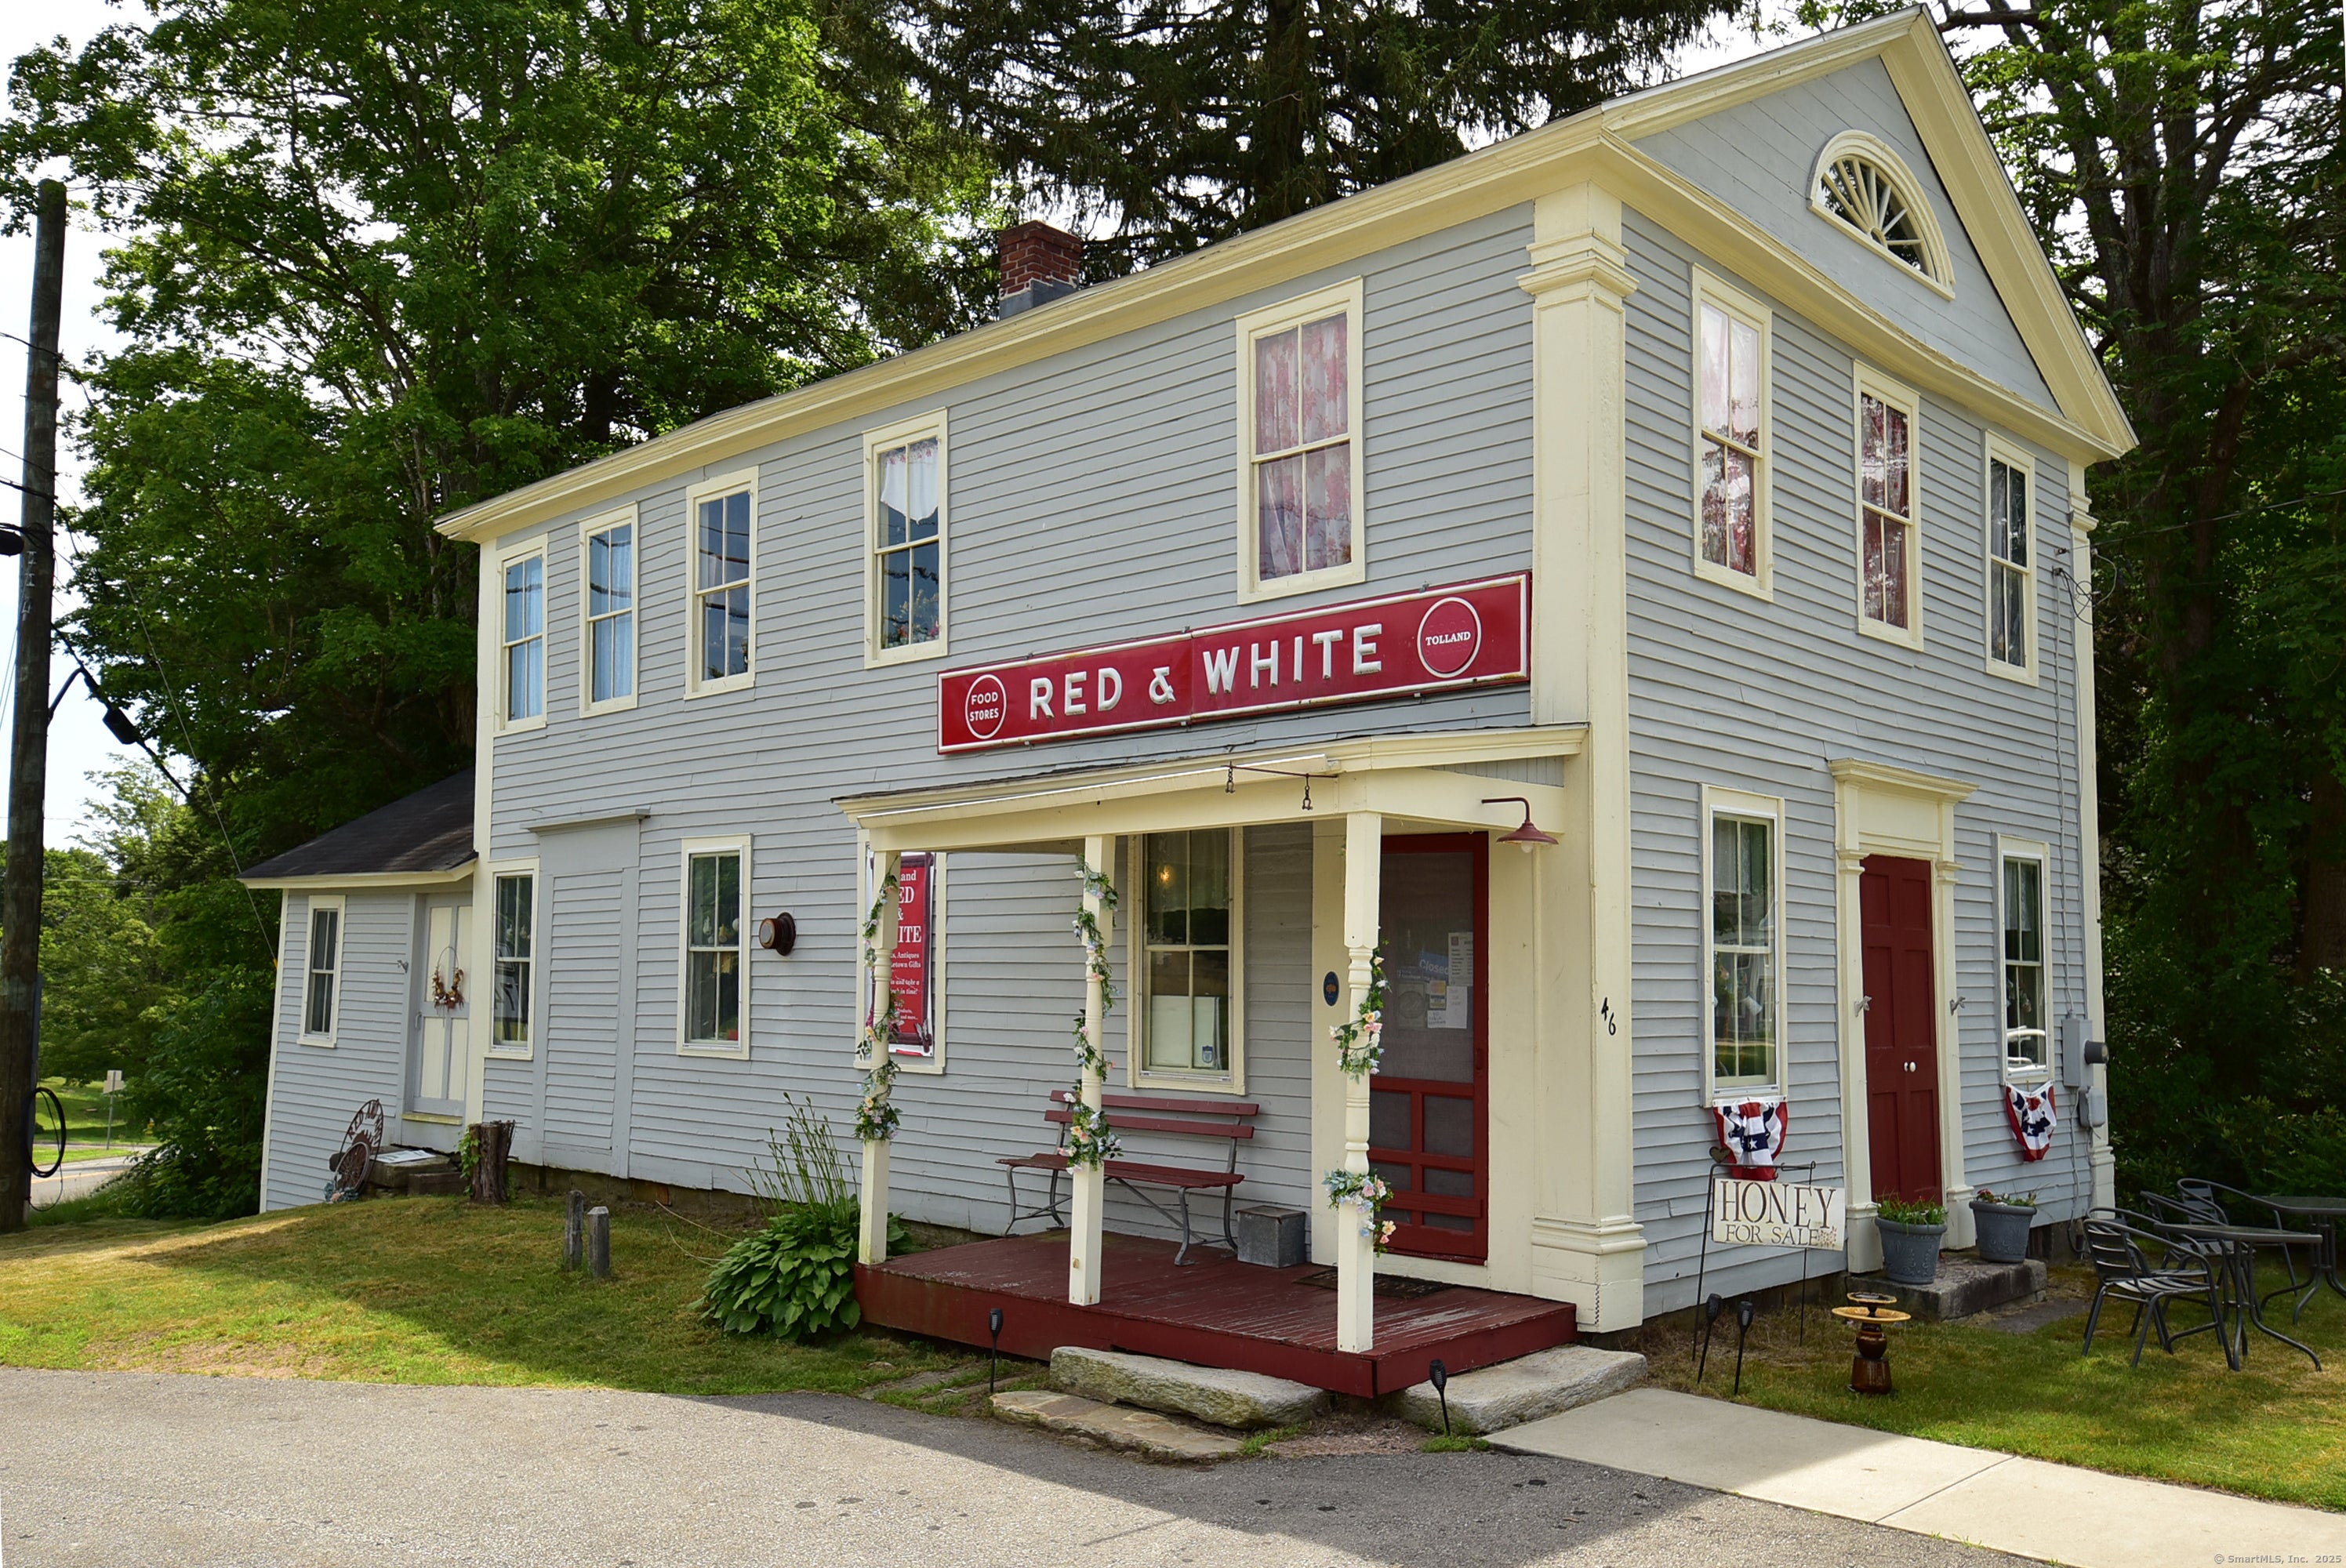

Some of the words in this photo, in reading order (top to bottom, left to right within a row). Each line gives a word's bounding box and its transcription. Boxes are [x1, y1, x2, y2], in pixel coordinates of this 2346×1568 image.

[1425, 630, 1472, 646] TOLLAND
[1030, 666, 1123, 720] RED
[1148, 666, 1176, 705] &
[1202, 622, 1382, 695] WHITE
[971, 691, 998, 706] FOOD
[969, 707, 1000, 722] STORES
[899, 869, 917, 881] and
[899, 886, 915, 904] ED
[898, 925, 922, 943] ITE
[897, 951, 920, 960] Antiques
[1601, 996, 1617, 1036] 46
[1720, 1181, 1836, 1229] HONEY
[1725, 1224, 1763, 1243] FOR
[1770, 1226, 1819, 1247] SALE
